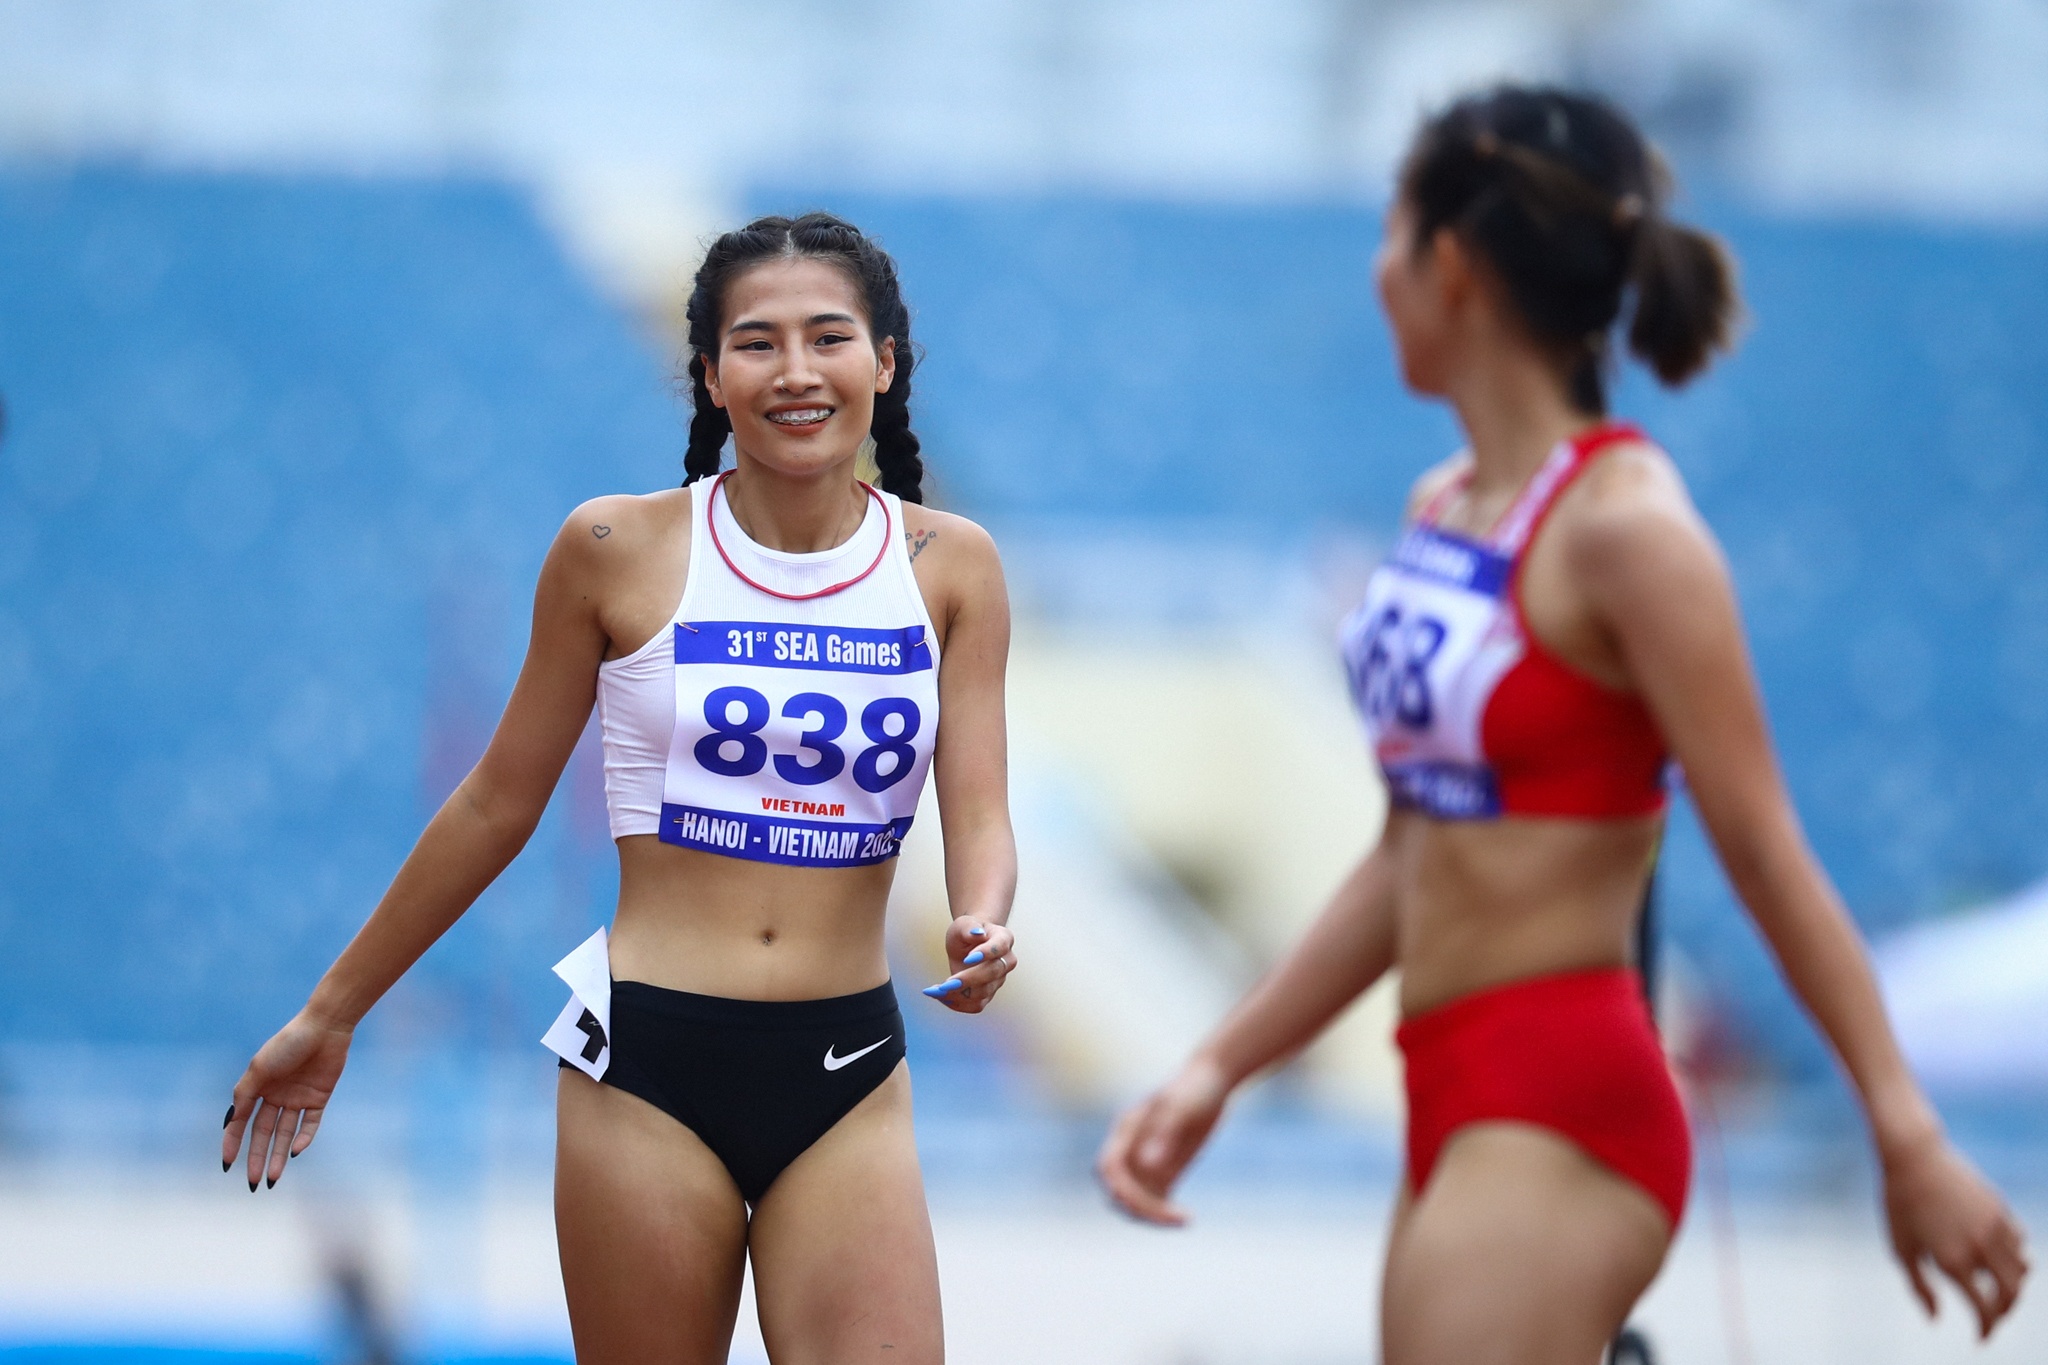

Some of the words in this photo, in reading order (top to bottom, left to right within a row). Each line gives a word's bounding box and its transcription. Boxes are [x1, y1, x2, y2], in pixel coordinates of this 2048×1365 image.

[774, 632, 819, 662] SEA
[826, 636, 901, 667] Games
[694, 686, 921, 794] 838
[761, 797, 845, 817] VIETNAM
[681, 812, 748, 850] HANOI
[768, 825, 859, 859] VIETNAM
